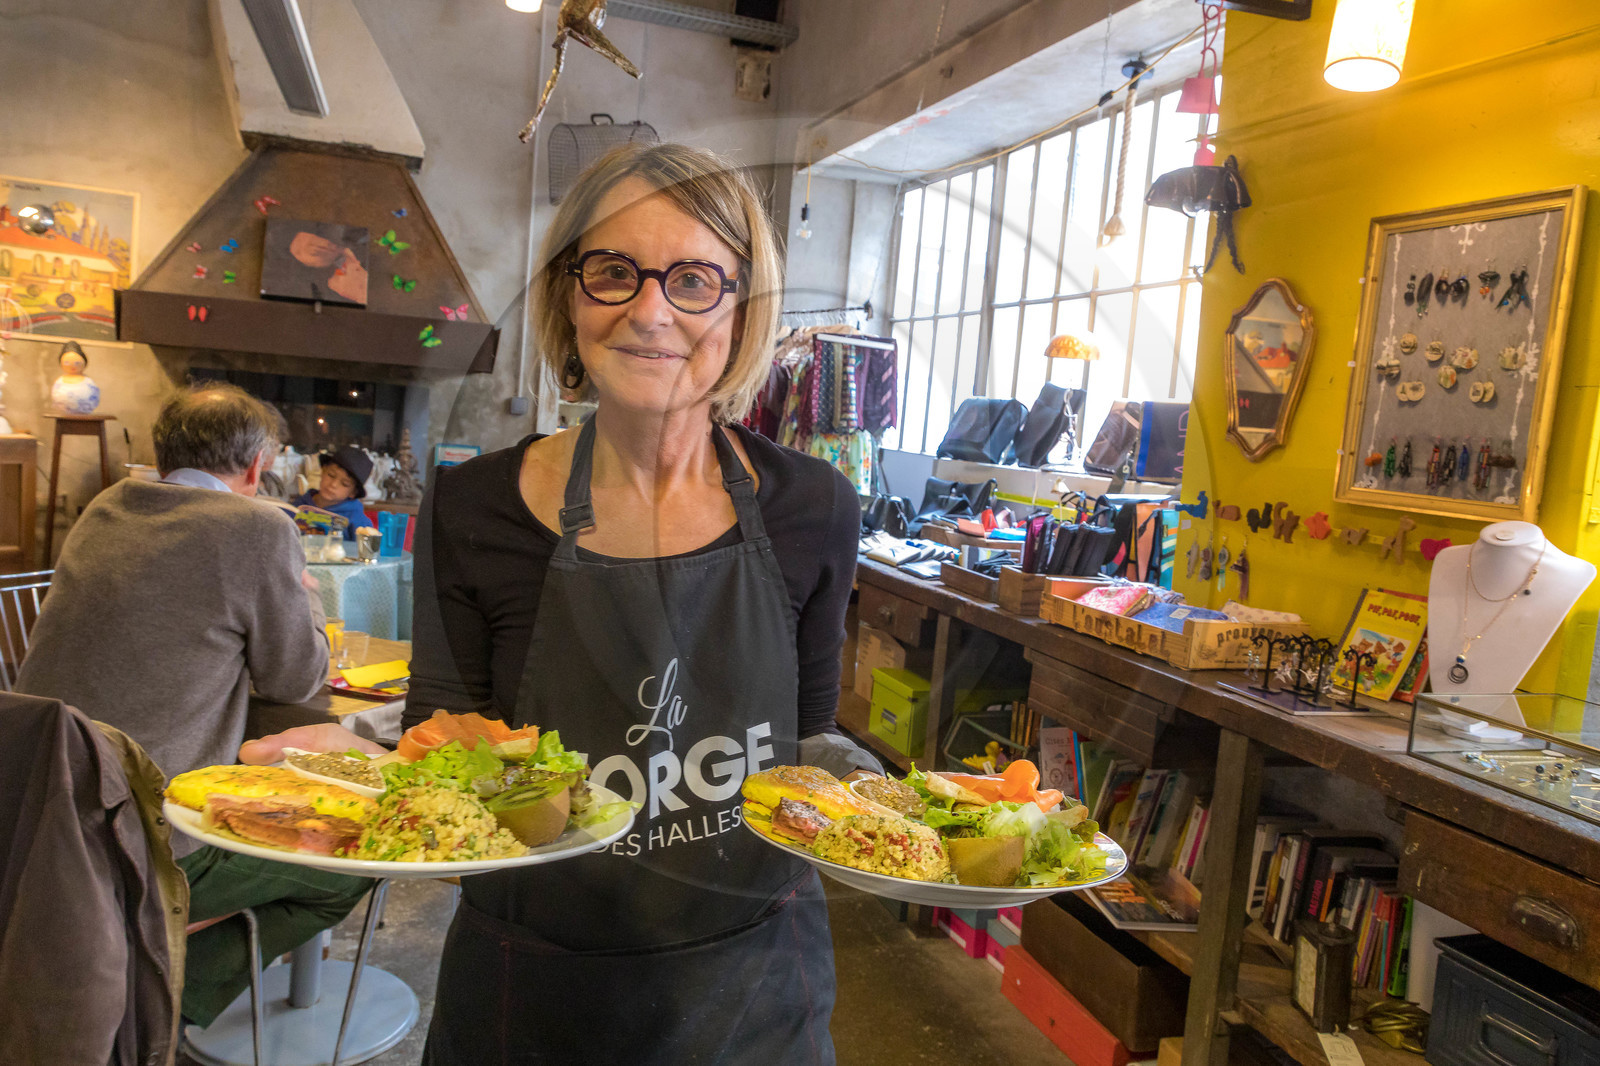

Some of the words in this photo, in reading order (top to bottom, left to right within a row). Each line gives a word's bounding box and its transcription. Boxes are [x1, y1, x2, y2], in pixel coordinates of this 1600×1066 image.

[626, 657, 688, 752] La
[578, 721, 775, 820] ORGE
[588, 833, 641, 857] ES
[649, 806, 741, 850] HALLES
